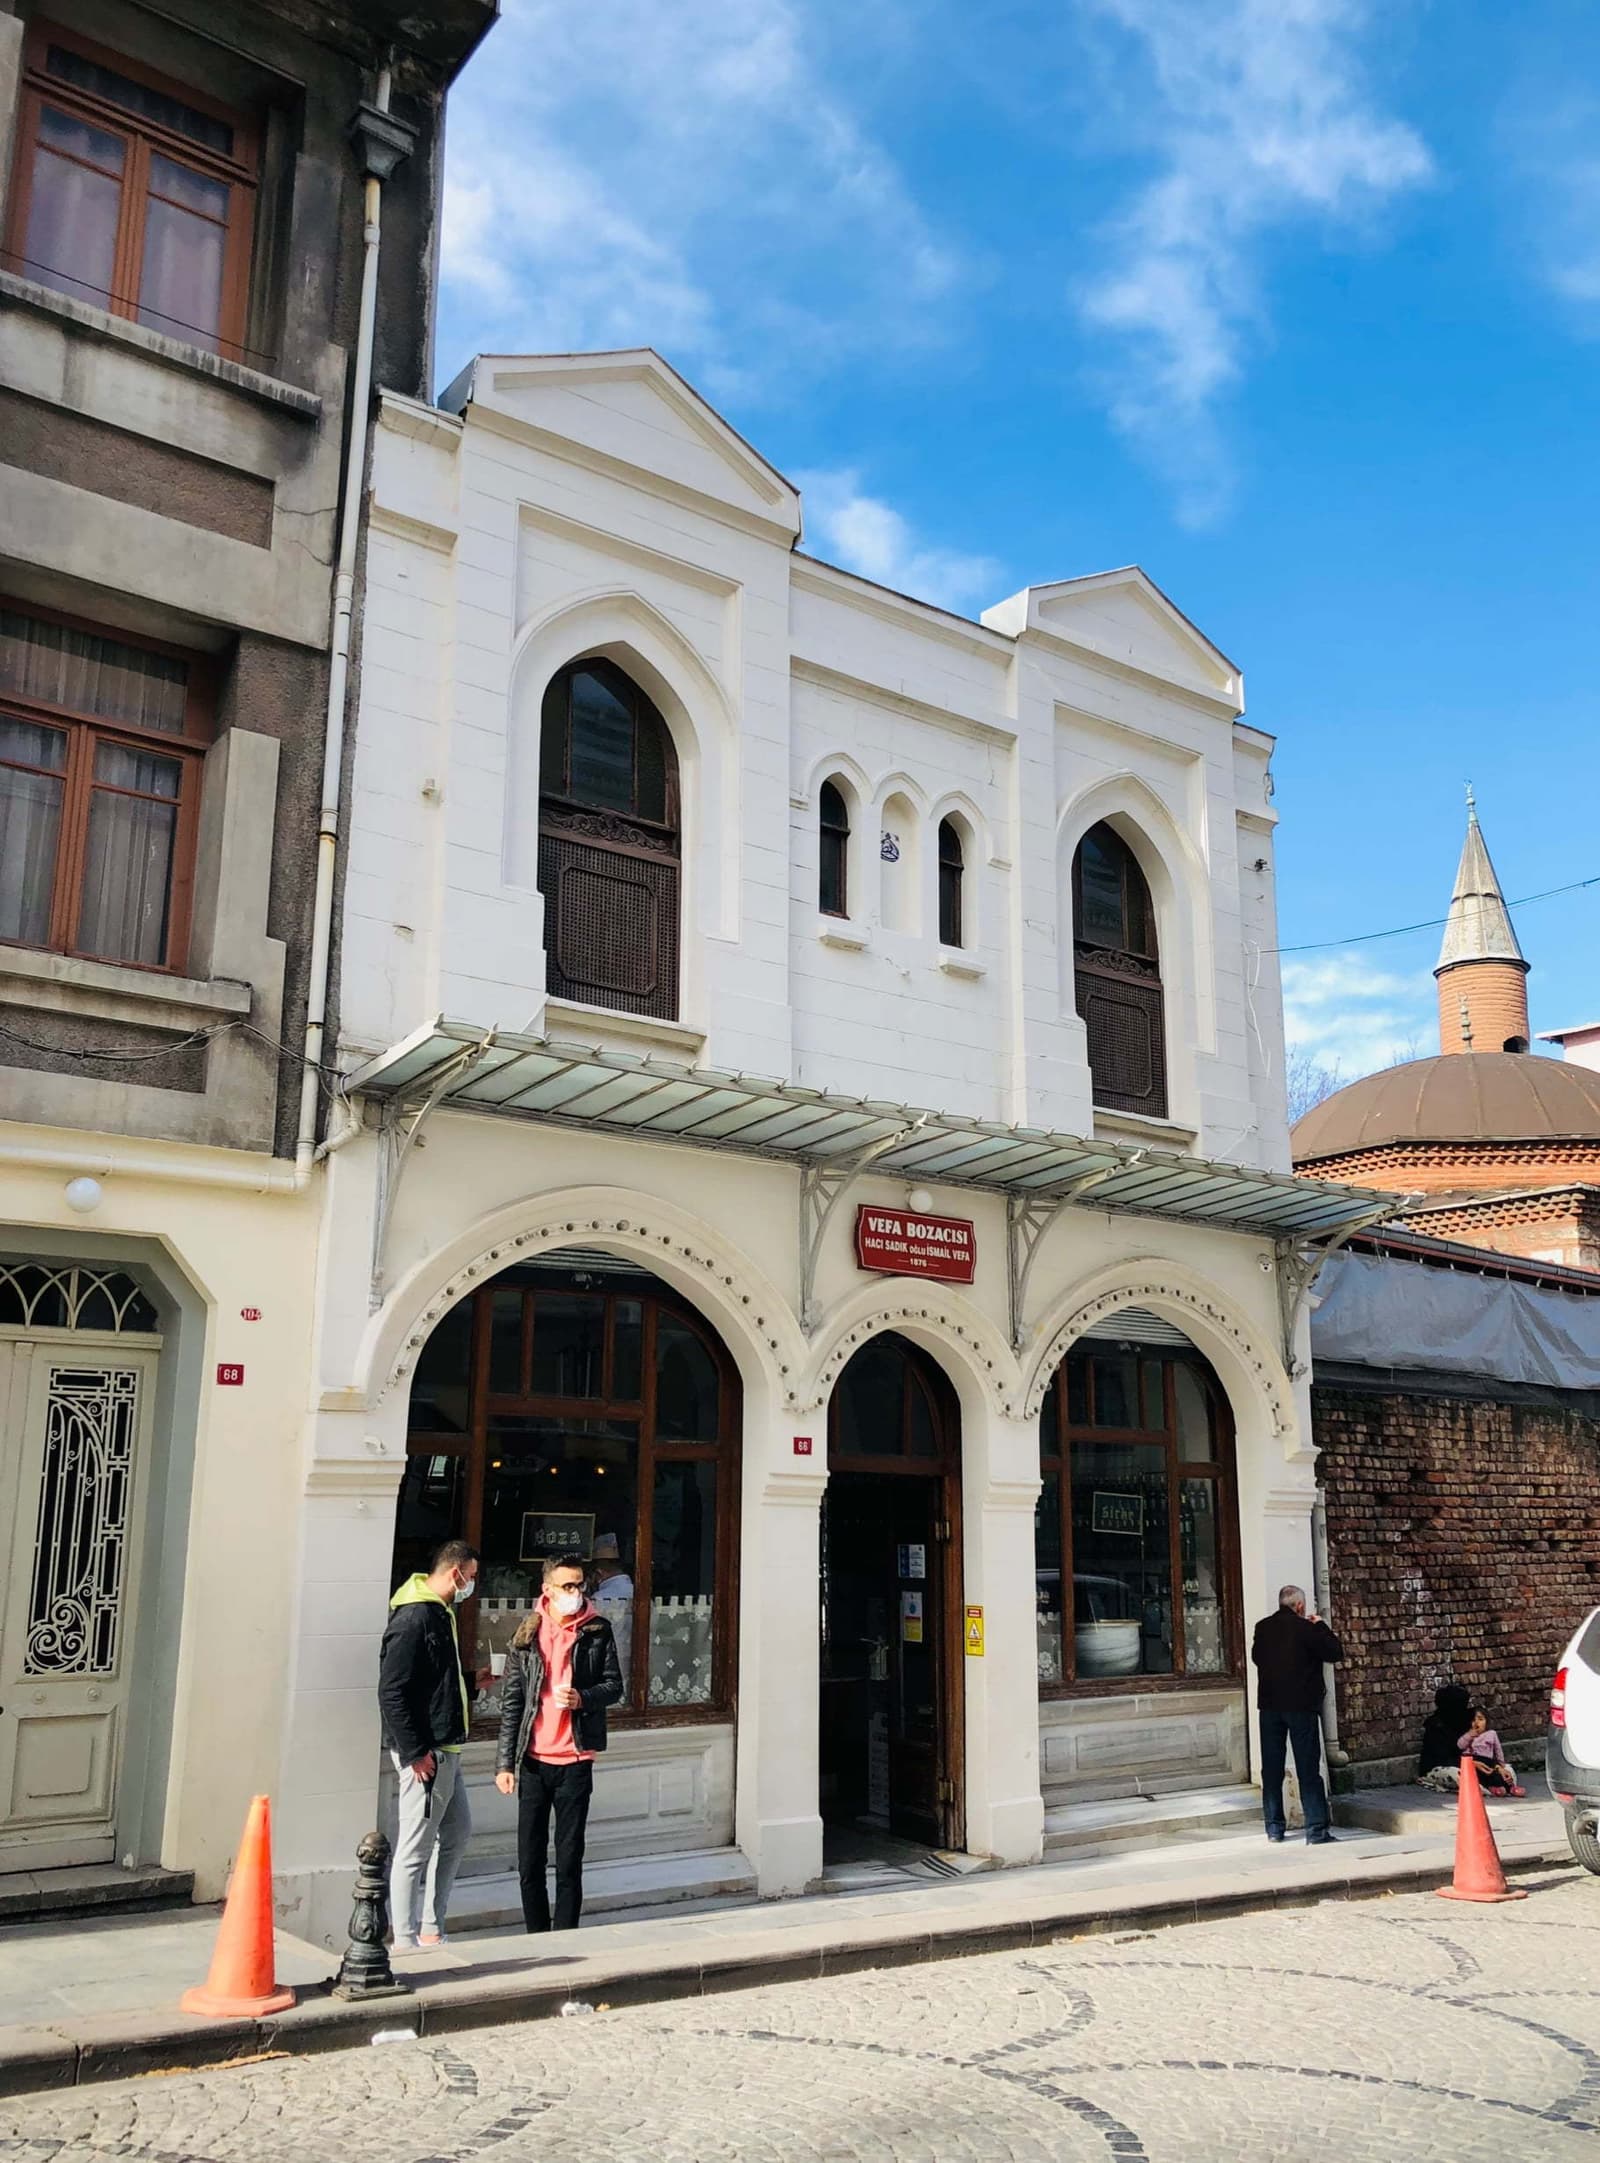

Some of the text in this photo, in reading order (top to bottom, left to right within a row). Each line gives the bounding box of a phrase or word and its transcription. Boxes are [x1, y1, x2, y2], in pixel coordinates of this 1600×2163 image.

[868, 1217, 968, 1245] VEFA BOZACISI
[865, 1238, 884, 1251] HACI
[885, 1240, 909, 1254] SADIK
[952, 1249, 970, 1261] VEFA
[910, 1258, 927, 1267] 1876
[224, 1369, 238, 1381] 68
